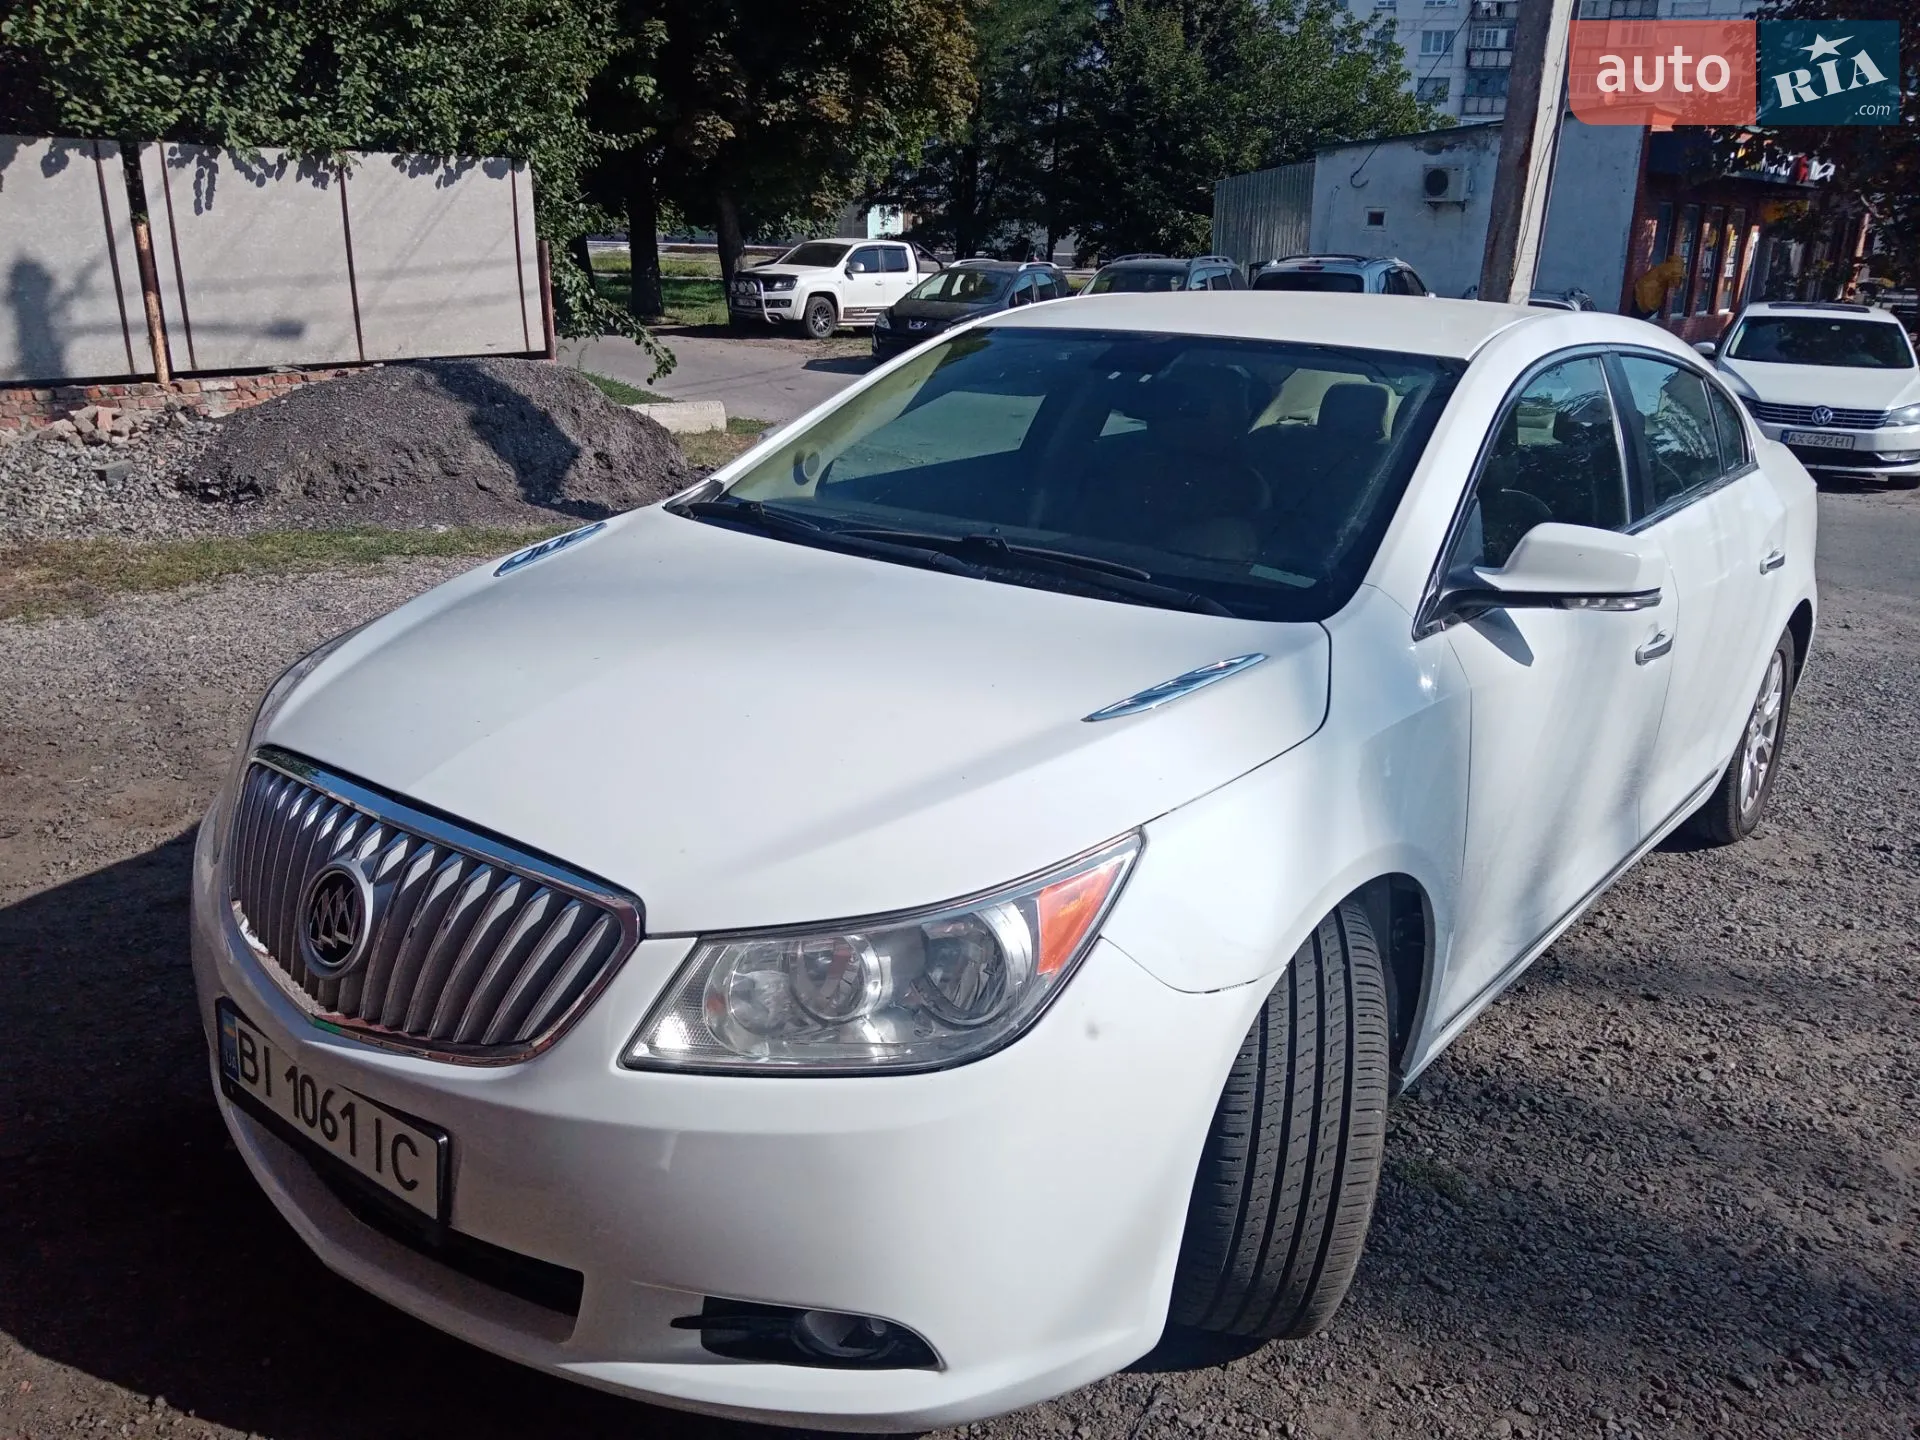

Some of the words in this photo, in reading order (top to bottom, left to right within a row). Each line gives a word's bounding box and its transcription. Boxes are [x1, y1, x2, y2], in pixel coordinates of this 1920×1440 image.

[238, 1030, 272, 1097] BI
[285, 1065, 357, 1158] 1061
[375, 1118, 419, 1192] IC
